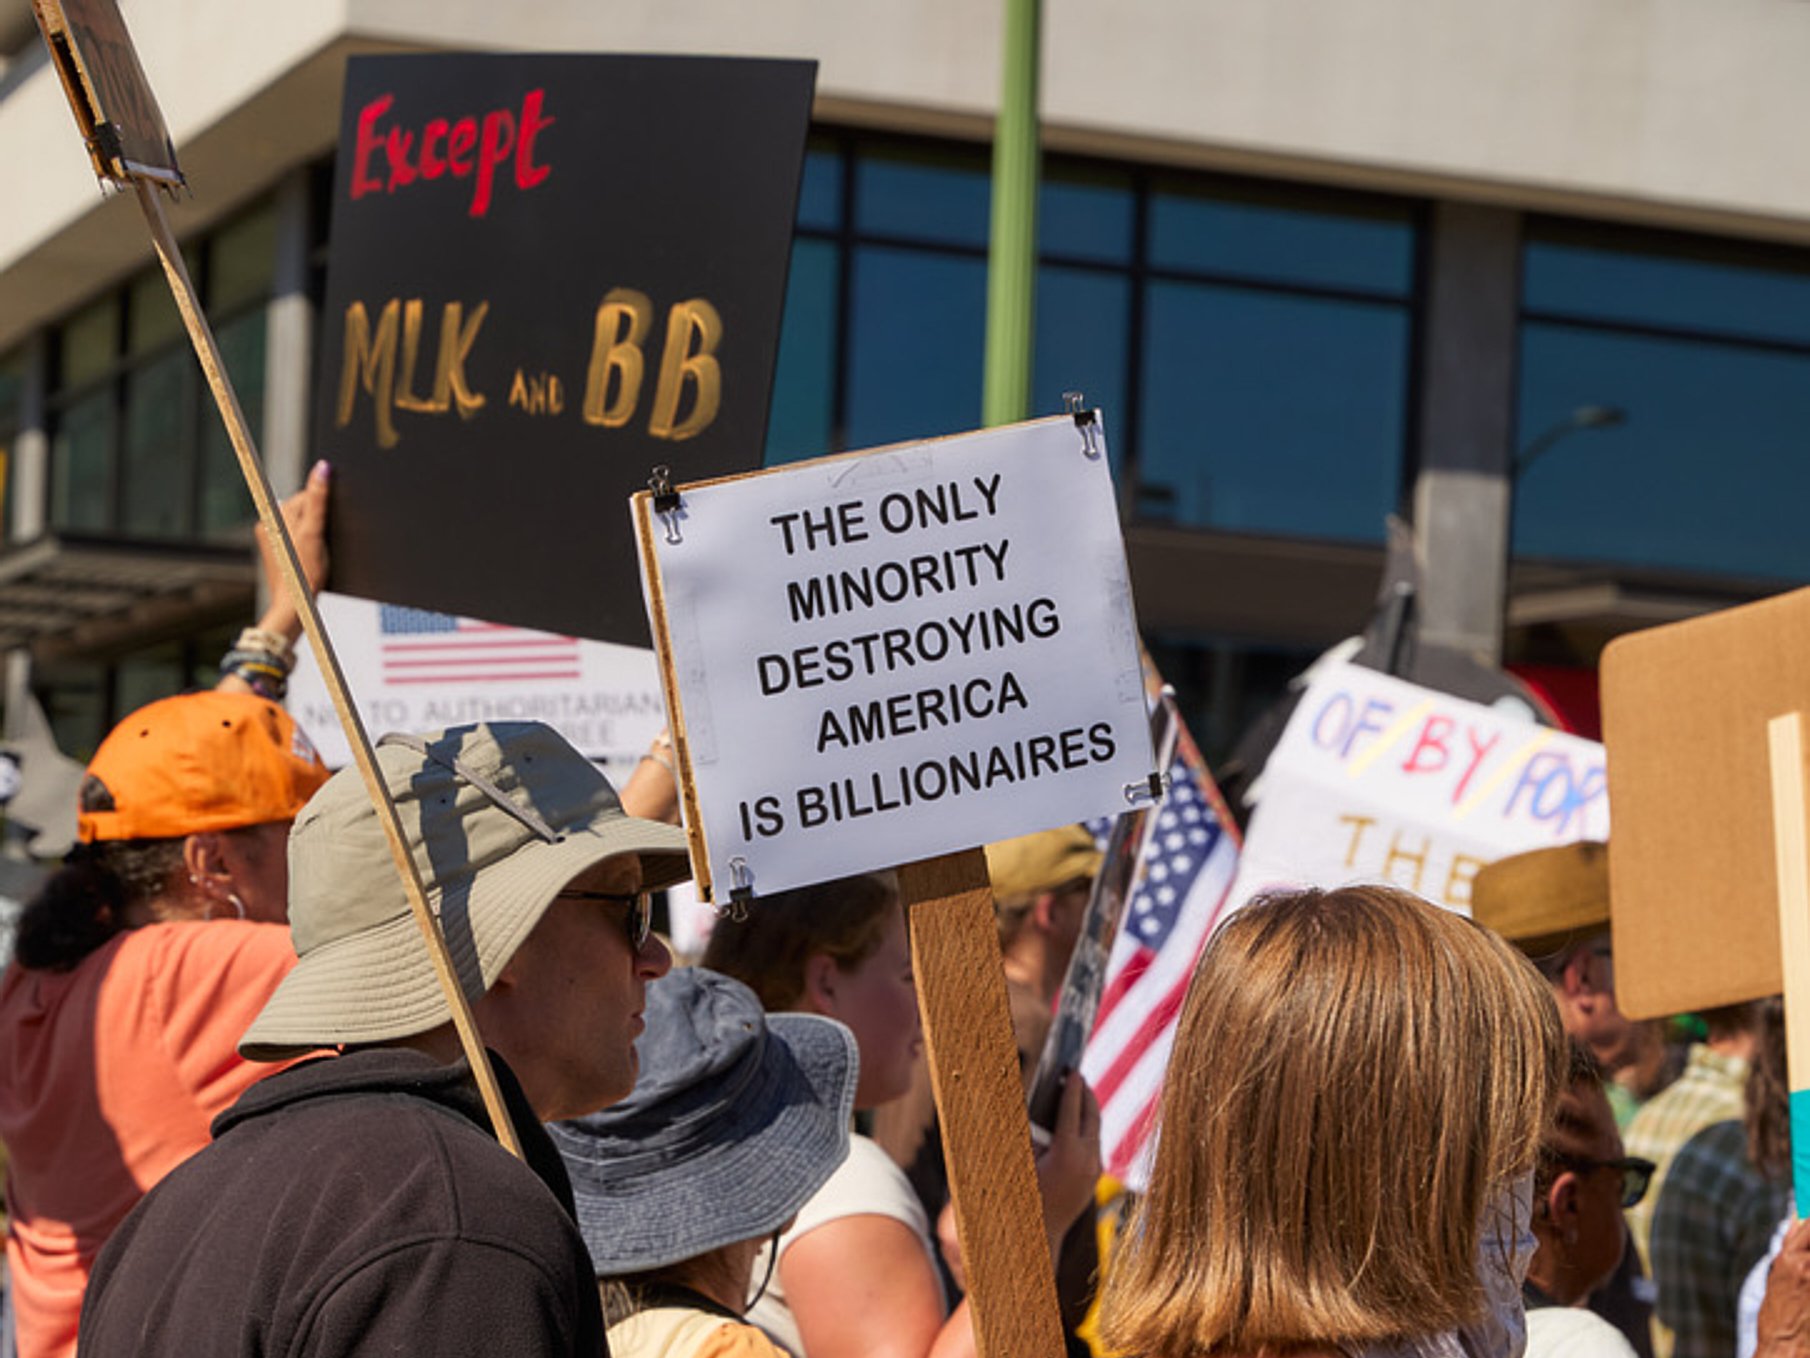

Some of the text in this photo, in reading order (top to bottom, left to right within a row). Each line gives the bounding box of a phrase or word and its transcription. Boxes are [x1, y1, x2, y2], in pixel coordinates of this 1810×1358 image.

[350, 88, 555, 216] Except
[337, 287, 722, 447] MLK AND BB
[771, 474, 1000, 554] THE ONLY
[788, 540, 1008, 622] MINORITY
[758, 599, 1059, 695] DESTROYING
[370, 700, 409, 724] TO
[818, 672, 1027, 752] AMERICA
[740, 723, 1115, 841] IS BILLIONAIRES
[1339, 814, 1487, 906] THE
